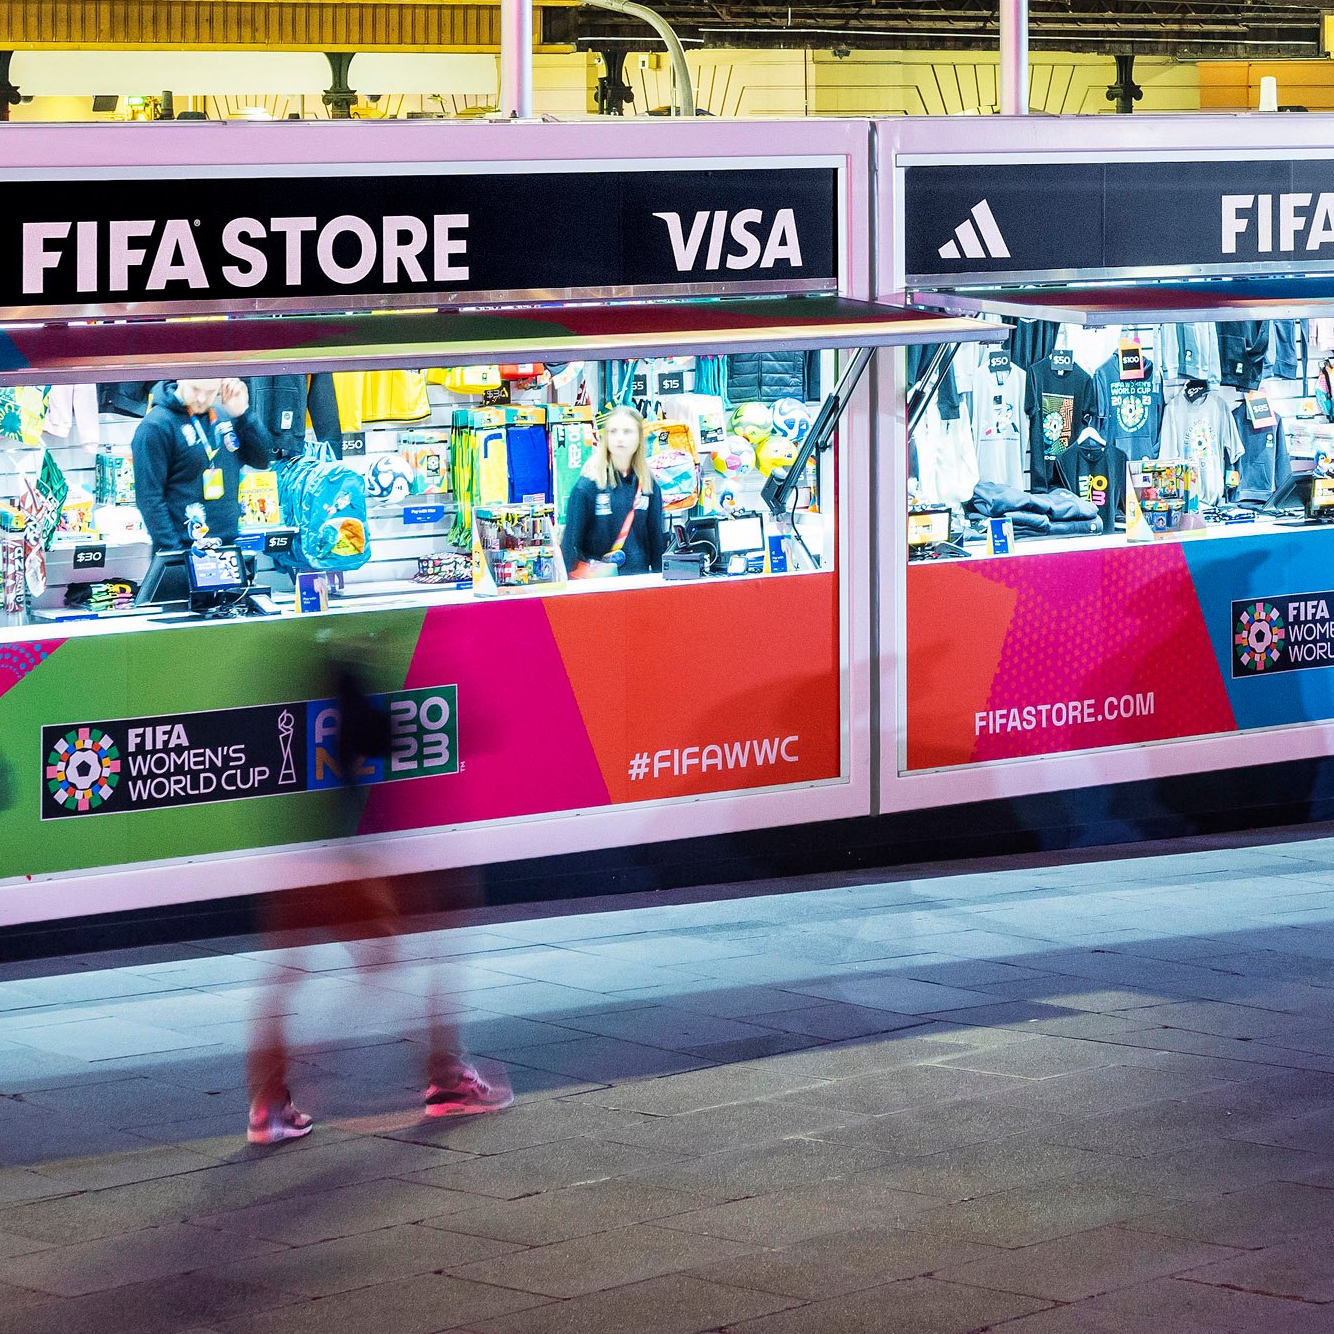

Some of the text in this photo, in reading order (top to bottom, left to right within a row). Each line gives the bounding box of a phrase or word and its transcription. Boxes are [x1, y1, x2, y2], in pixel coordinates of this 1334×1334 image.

[22, 212, 470, 295] FIFA STORE
[652, 207, 805, 272] VISA
[990, 357, 1009, 367] $50
[1053, 356, 1071, 365] $50
[1122, 356, 1139, 364] $100
[662, 380, 680, 390] $15
[1137, 387, 1151, 395] CUP
[76, 551, 102, 563] $30
[269, 537, 289, 548] $15
[1288, 599, 1330, 622] FIFA
[390, 696, 450, 736] 20
[974, 691, 1155, 736] FIFASTORE.COM
[128, 723, 190, 752] FIFA
[128, 744, 246, 777] WOMEN'S
[390, 734, 450, 772] 23
[628, 734, 799, 781] #FIFAWWC
[128, 766, 270, 802] WORLD CUP
